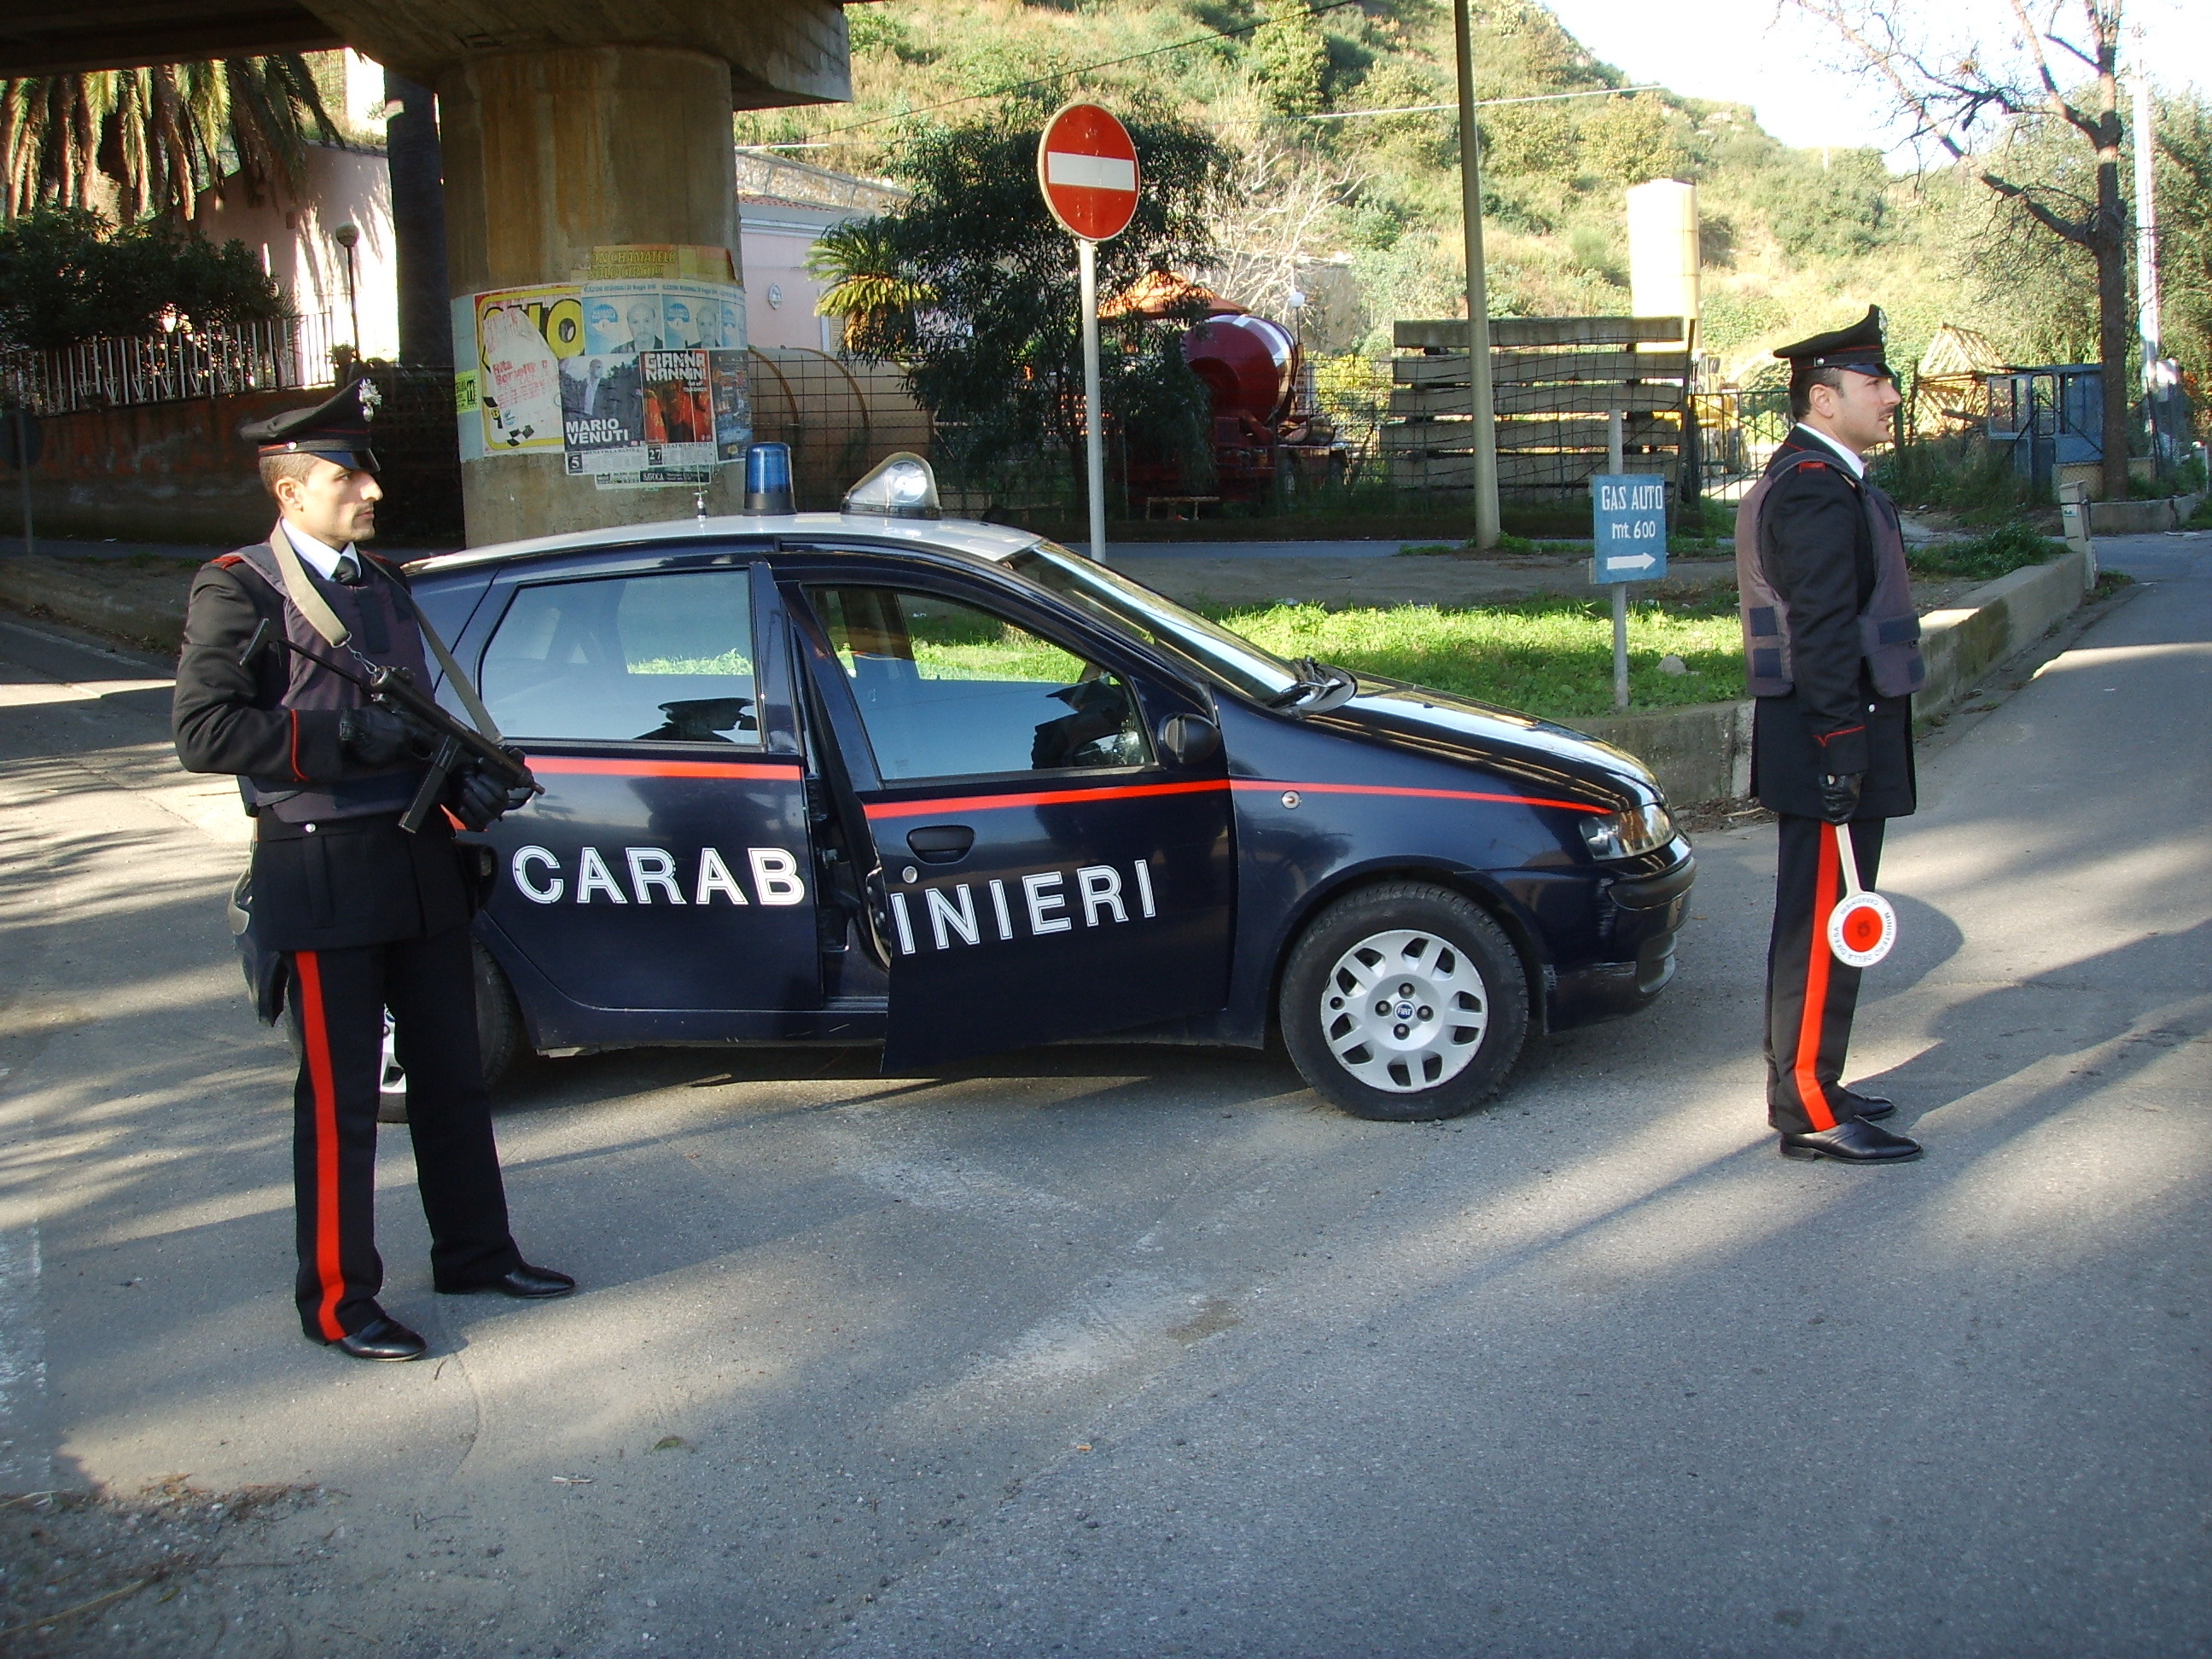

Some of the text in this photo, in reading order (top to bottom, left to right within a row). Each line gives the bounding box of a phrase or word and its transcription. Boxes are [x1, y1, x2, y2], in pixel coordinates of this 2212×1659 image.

[645, 352, 706, 368] GIANNA
[646, 367, 707, 381] NANNINI
[566, 417, 620, 433] MARIO
[567, 428, 629, 445] VENUTI
[571, 457, 579, 469] 5
[649, 450, 661, 461] 27
[1602, 485, 1663, 511] GAS AUTO
[1612, 520, 1656, 539] mt. 600
[512, 845, 1156, 955] CARAB INIERI
[1833, 911, 1893, 963] MINISTERO DELLA DIFESA
